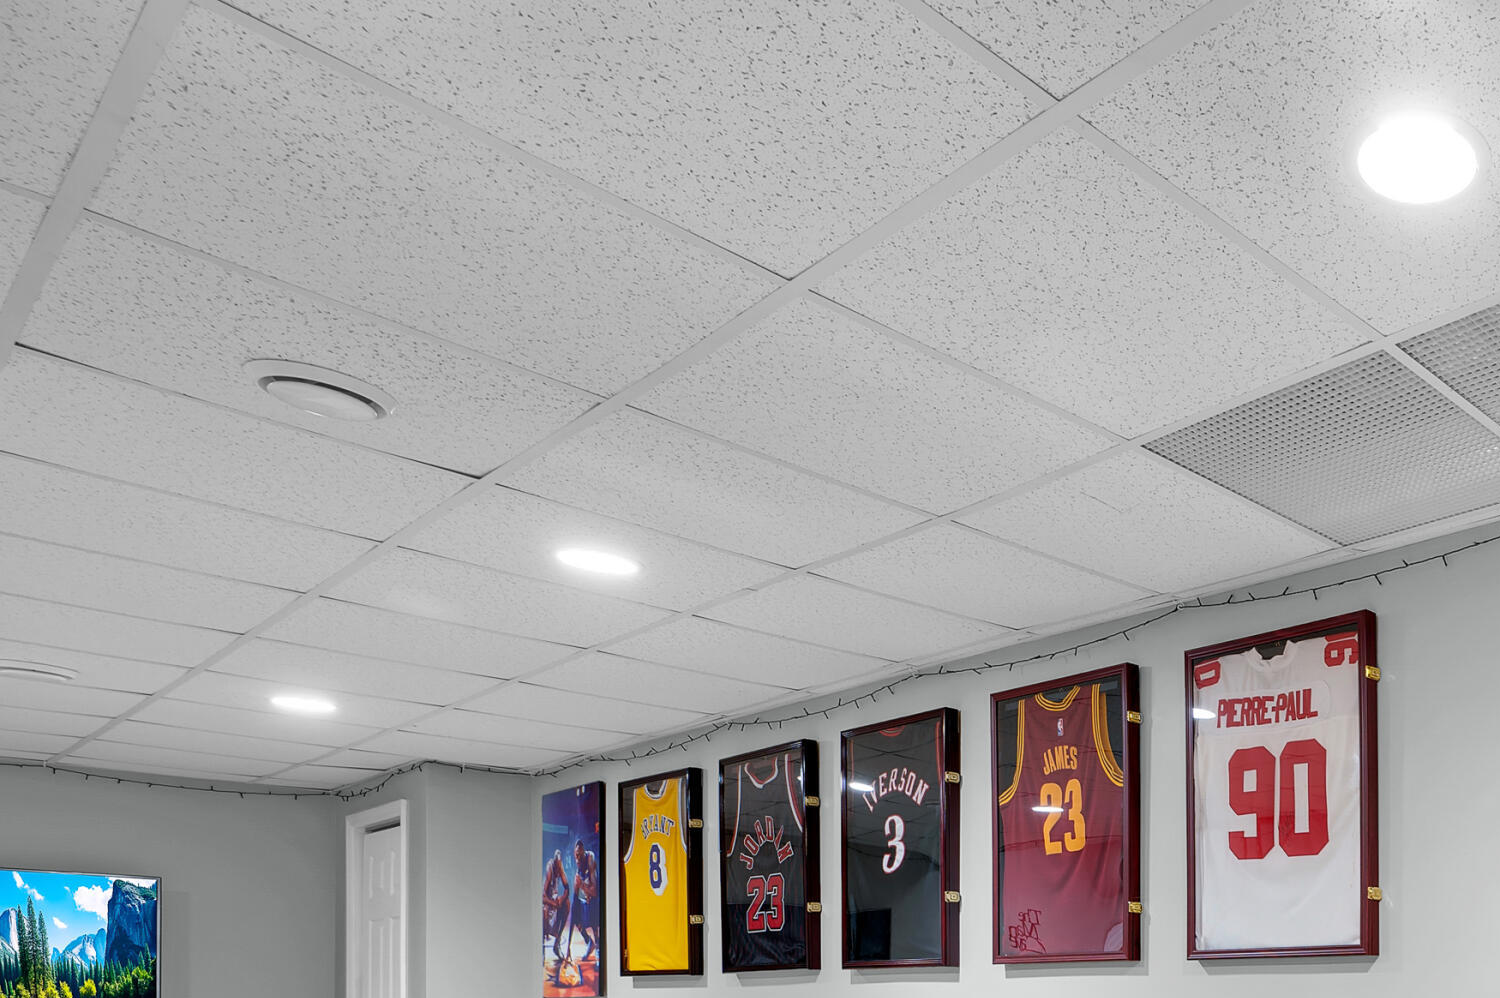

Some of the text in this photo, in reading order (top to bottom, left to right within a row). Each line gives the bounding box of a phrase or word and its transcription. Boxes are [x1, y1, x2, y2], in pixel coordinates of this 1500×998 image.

[1217, 688, 1318, 729] PIERRE-PAUL
[1043, 745, 1078, 776] JAMES
[862, 767, 930, 814] IVERSON
[1040, 778, 1086, 855] 23
[1228, 738, 1329, 860] 90
[649, 843, 666, 893] 8
[882, 814, 906, 874] 3
[746, 872, 785, 933] 23
